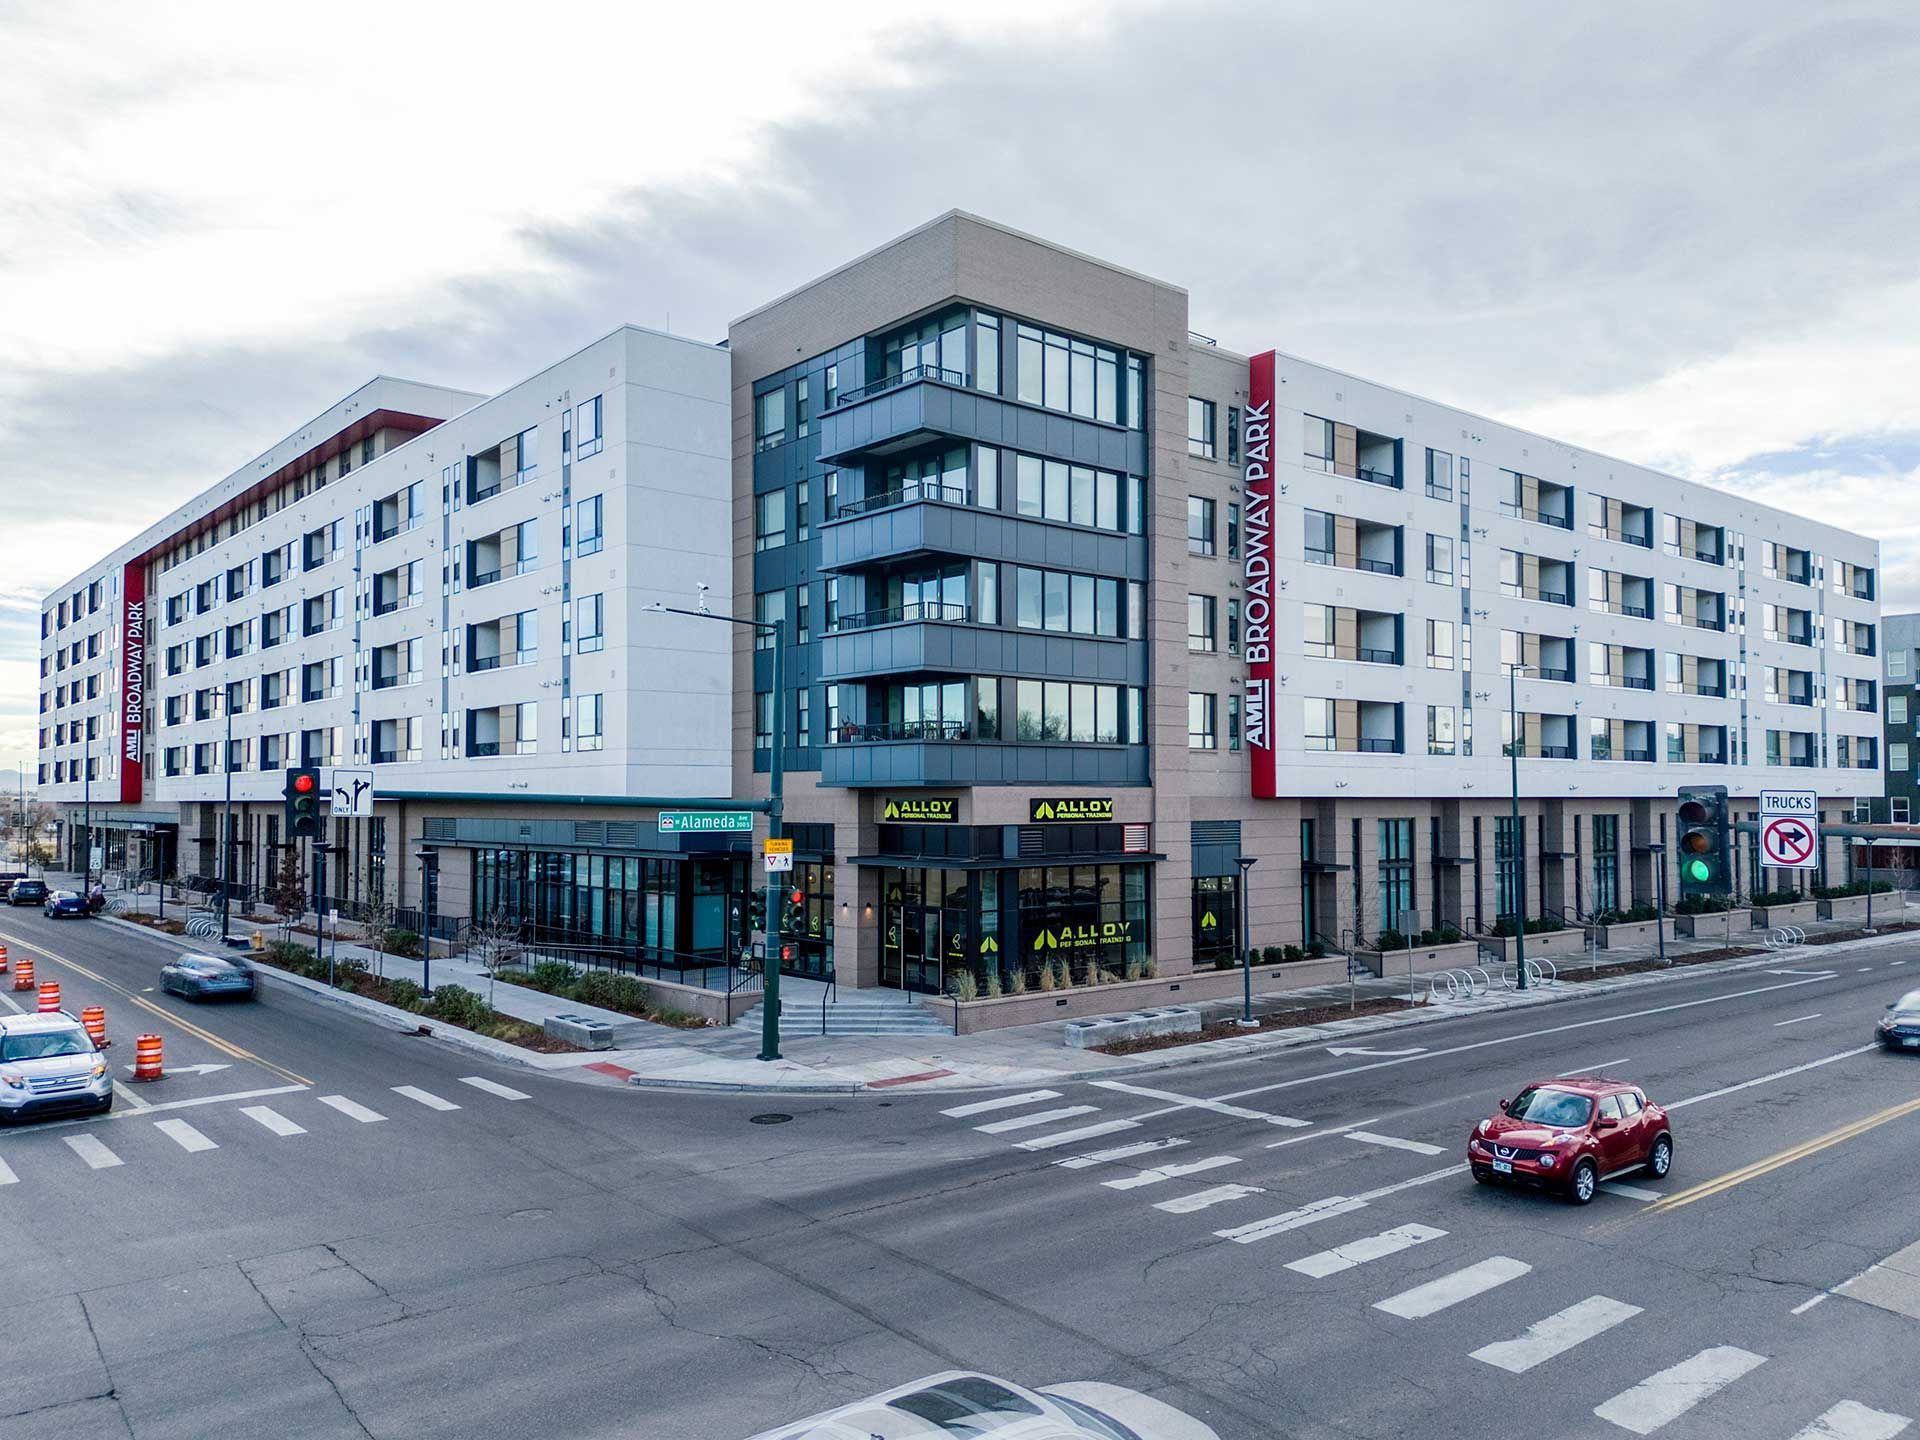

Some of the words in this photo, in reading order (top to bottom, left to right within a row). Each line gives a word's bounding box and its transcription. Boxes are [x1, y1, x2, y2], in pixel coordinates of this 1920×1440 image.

[1245, 400, 1270, 481] PARK
[1245, 489, 1270, 664] BROADWAY
[127, 601, 144, 639] PARK
[126, 641, 143, 723] BROADWAY
[1245, 679, 1263, 748] AMLI
[126, 729, 137, 761] AMLI
[900, 801, 952, 812] ALLOY
[1056, 801, 1113, 812] ALLOY
[1765, 796, 1812, 809] TRUCKS
[681, 815, 735, 829] Alameda
[1060, 922, 1130, 940] ALLOY
